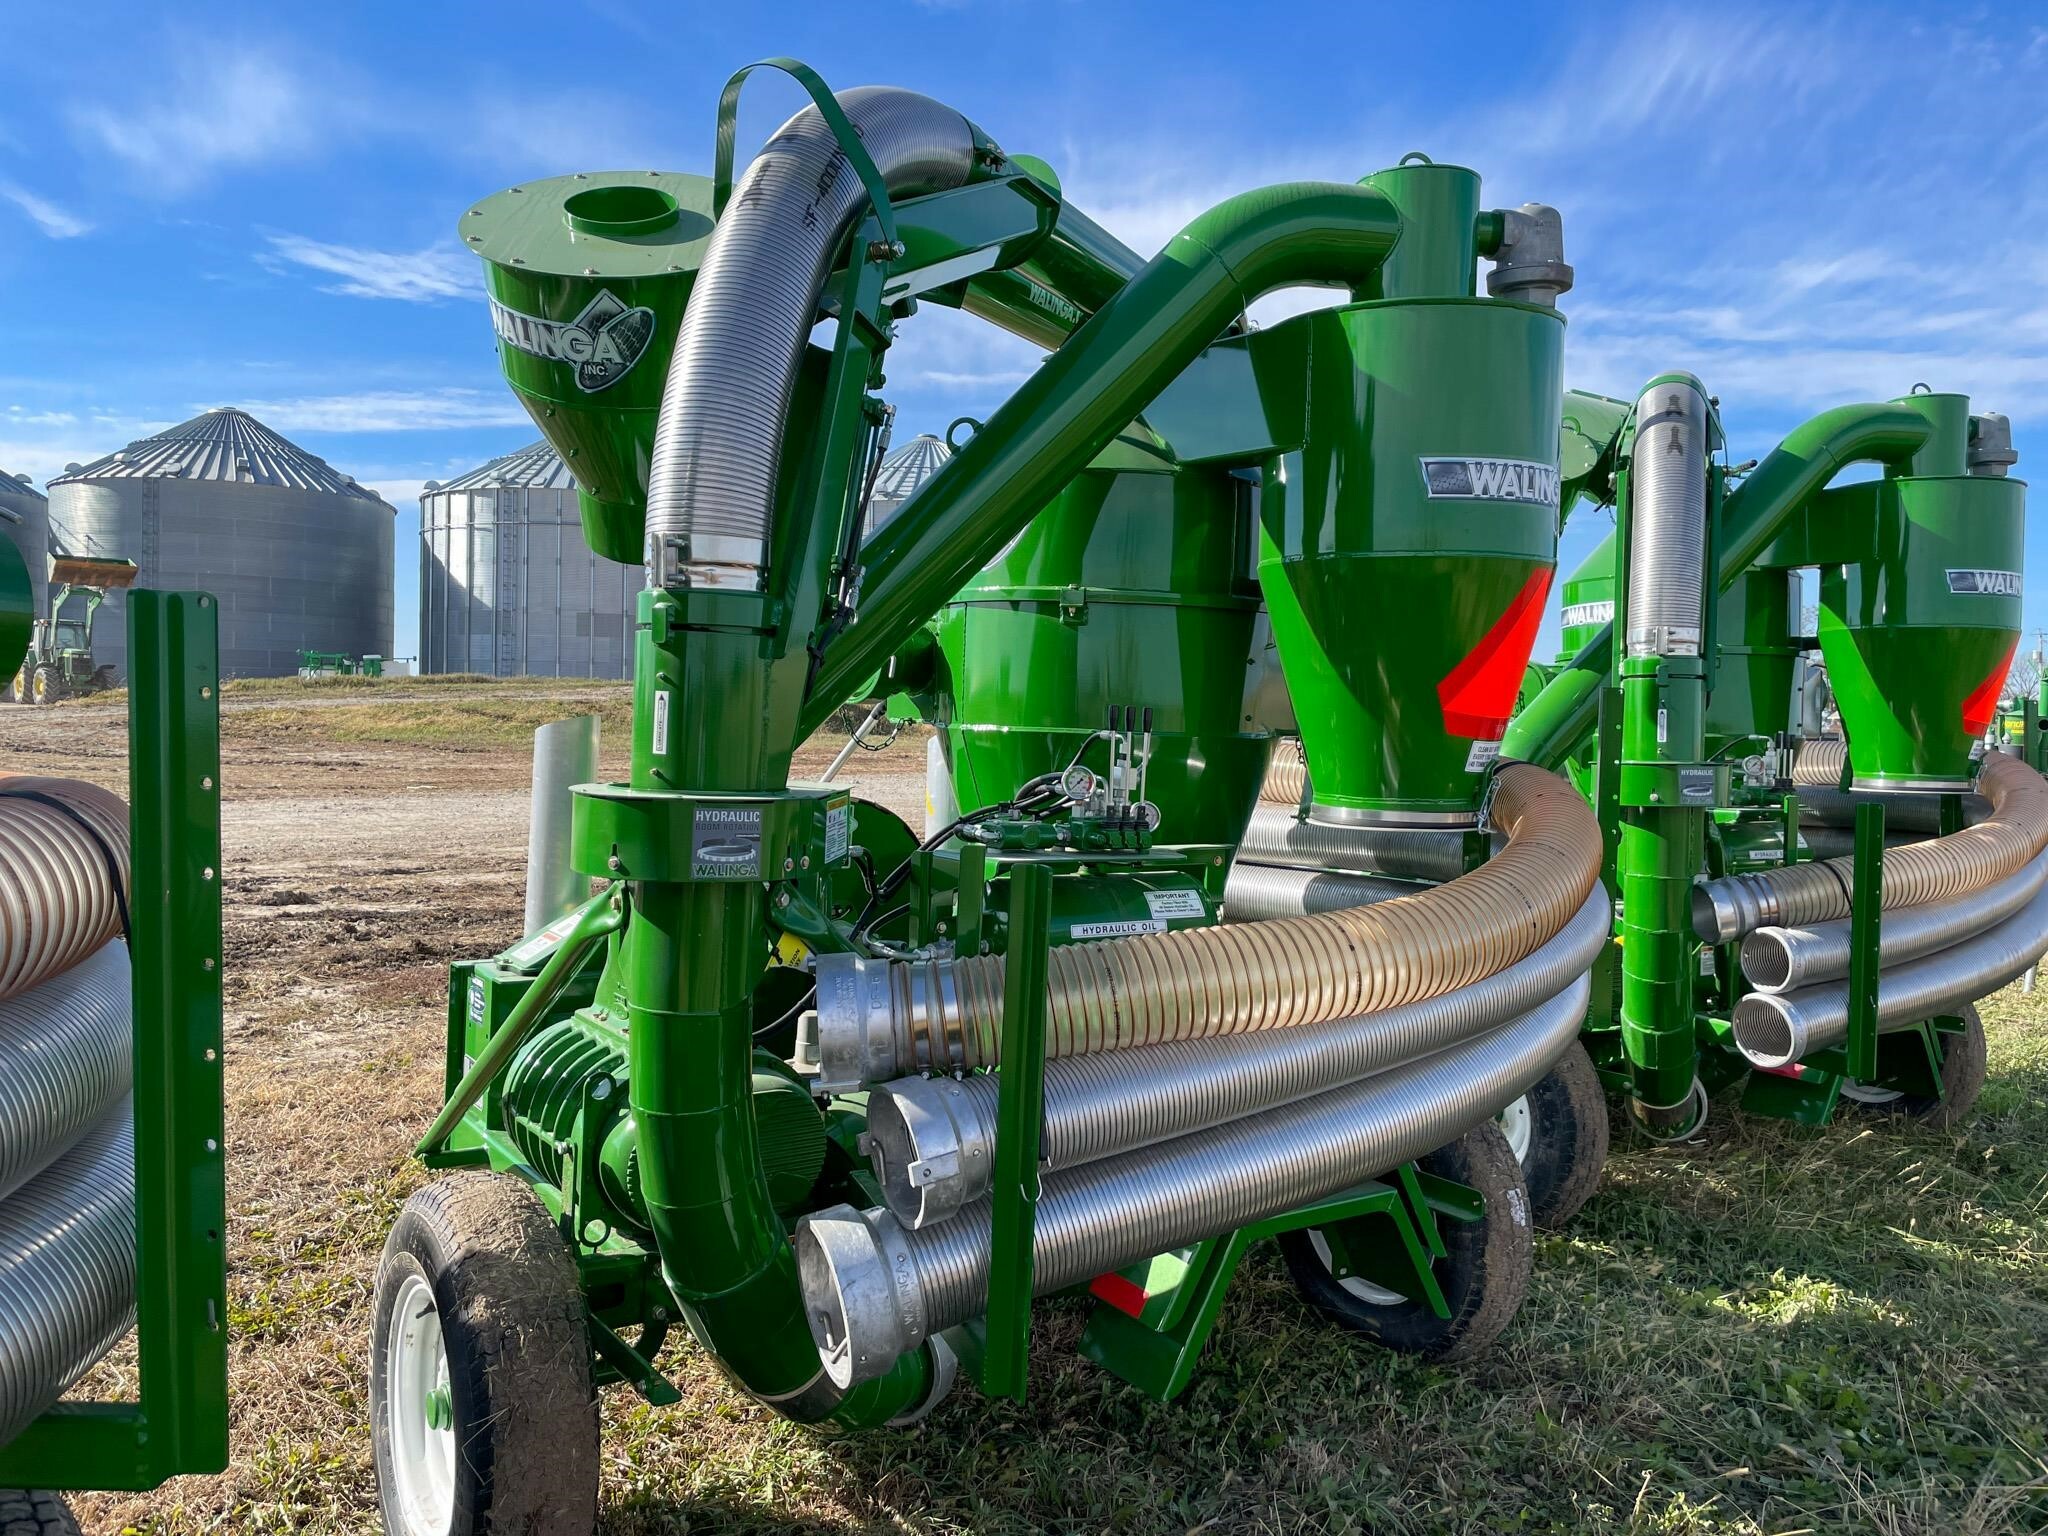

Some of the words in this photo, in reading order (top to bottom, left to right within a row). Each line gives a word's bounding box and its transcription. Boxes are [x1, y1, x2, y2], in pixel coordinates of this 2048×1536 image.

[488, 302, 625, 364] WALINGA
[583, 363, 609, 376] INC.
[695, 810, 760, 822] HYDRAULIC
[695, 823, 720, 831] BOOM
[723, 823, 760, 831] ROTATION
[692, 863, 758, 877] WALINGA
[1082, 924, 1137, 935] HYDRAULIC
[1141, 922, 1157, 931] OIL
